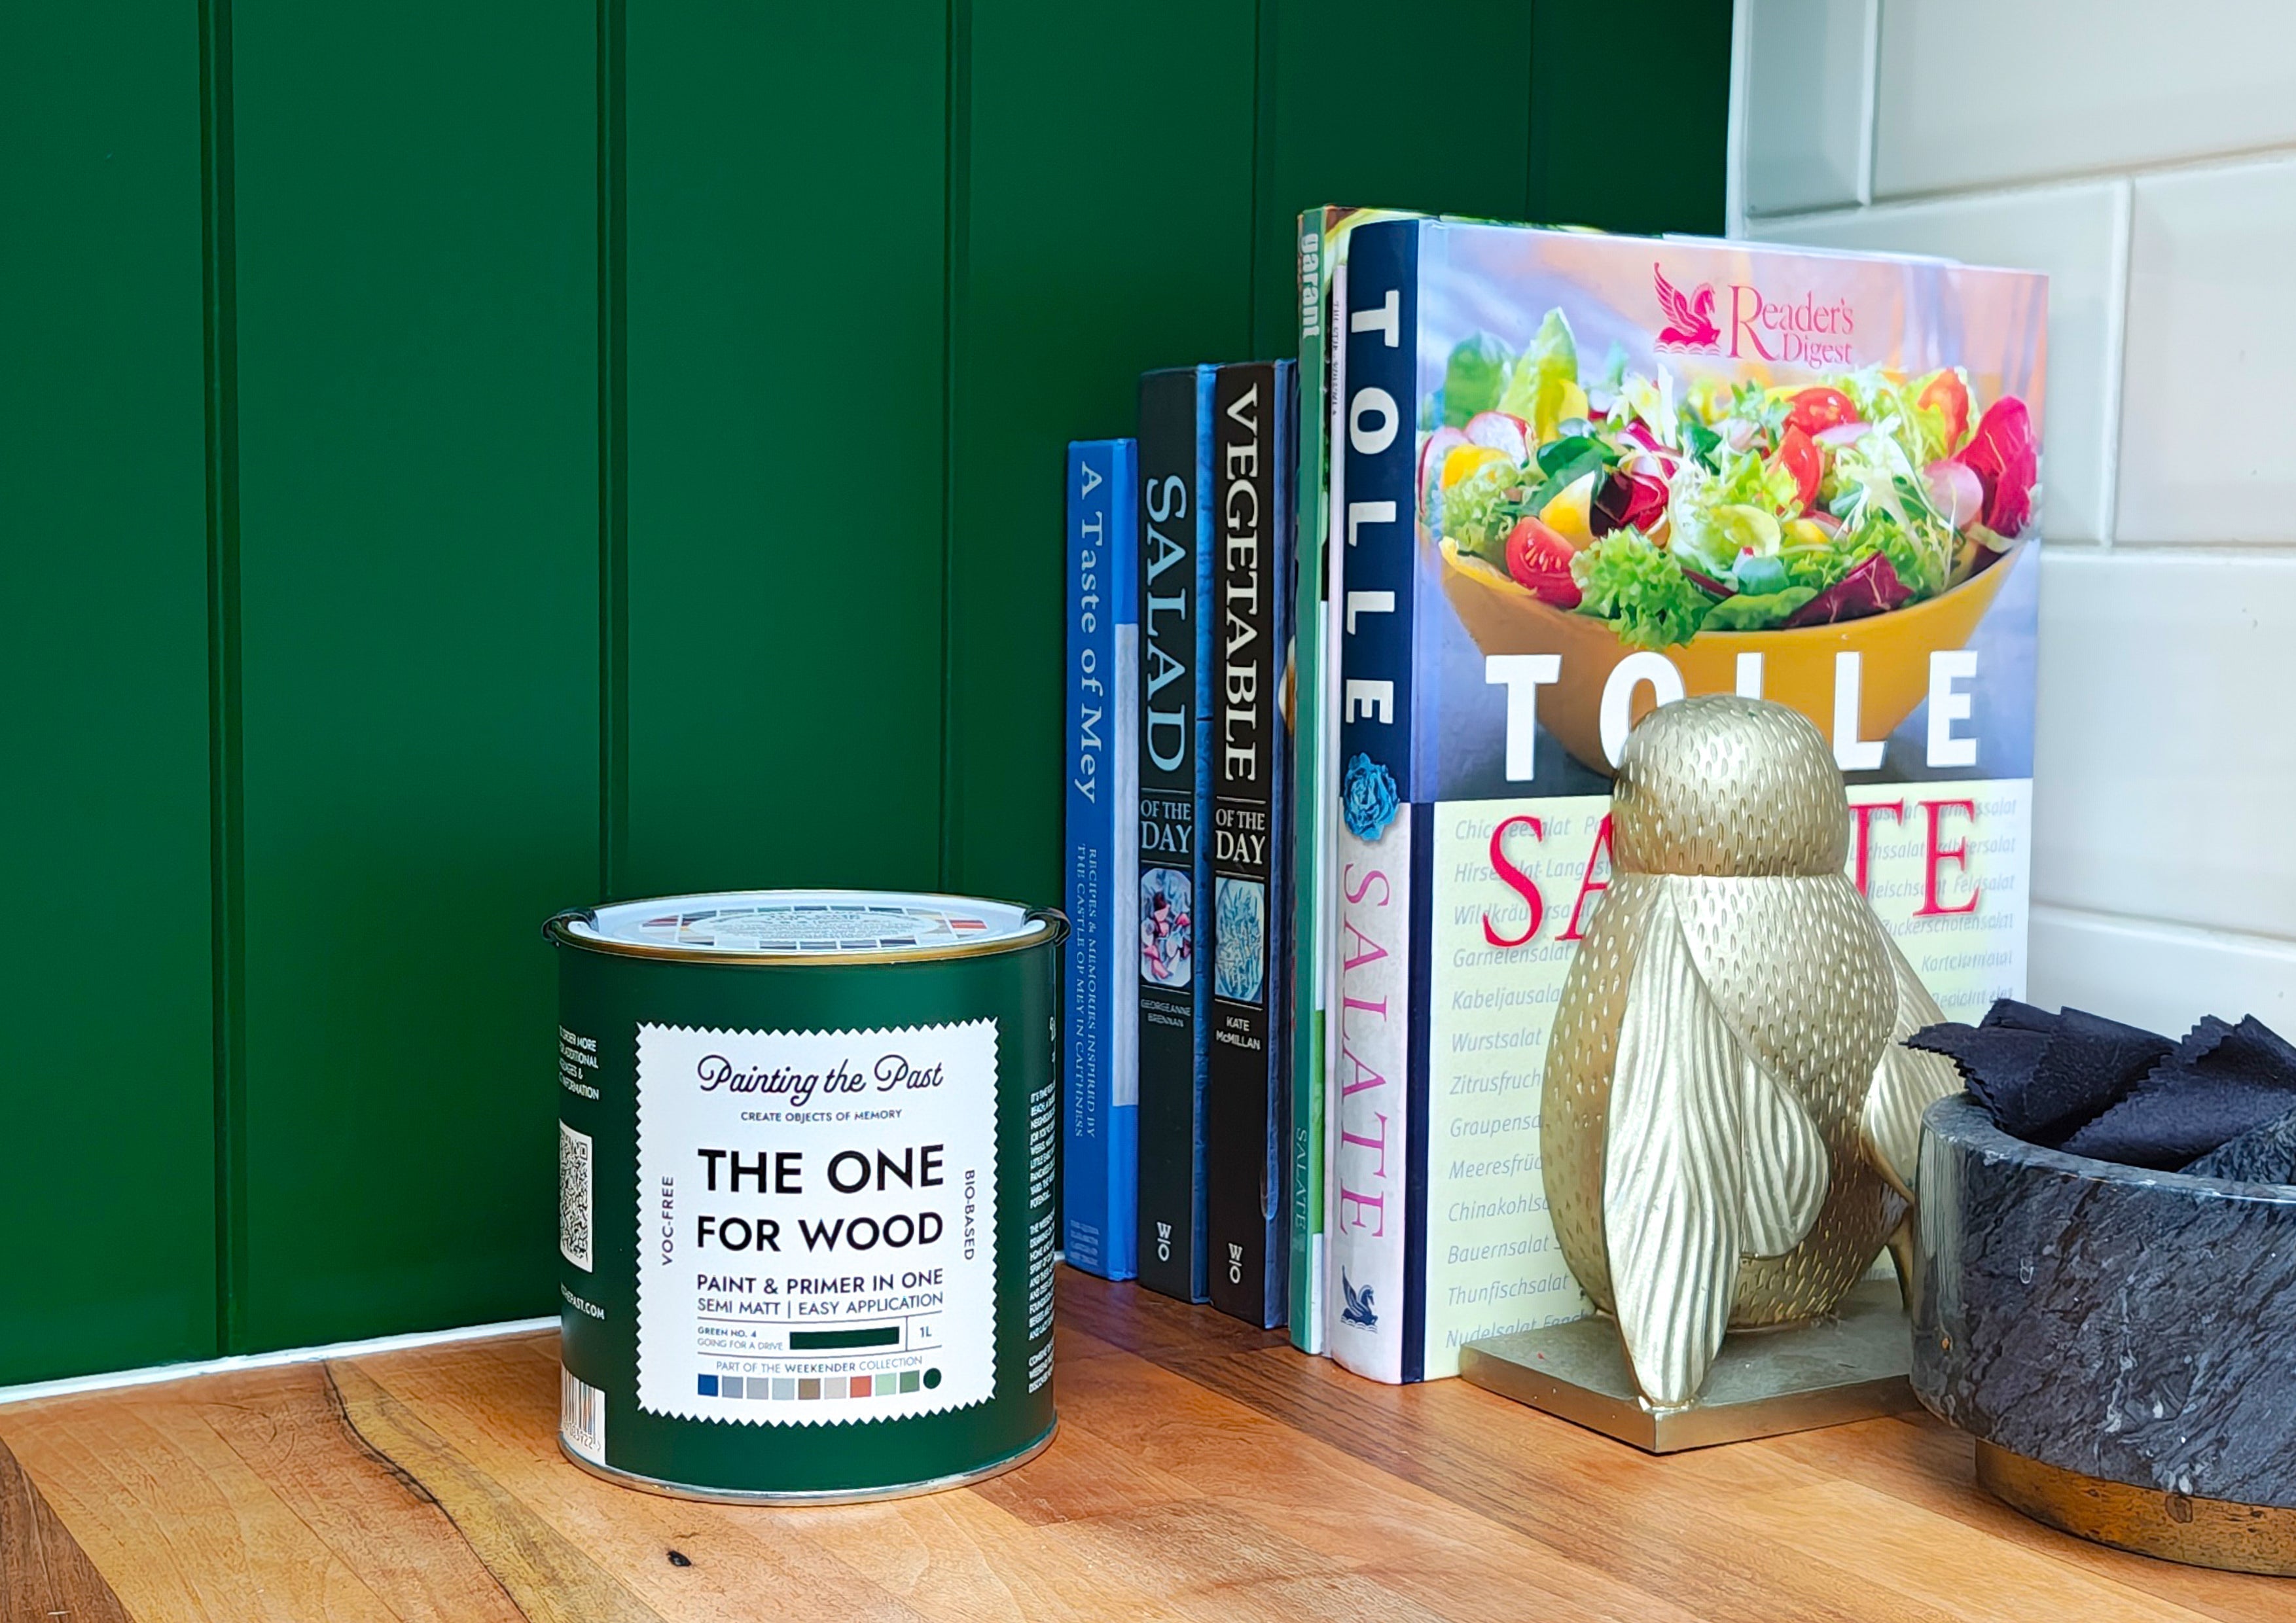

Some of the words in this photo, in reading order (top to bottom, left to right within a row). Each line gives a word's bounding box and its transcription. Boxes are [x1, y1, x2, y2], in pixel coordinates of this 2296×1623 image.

[1728, 285, 1854, 361] Reader's
[1783, 333, 1852, 369] Digest
[1081, 461, 1102, 499] A
[1346, 289, 1399, 724] TOLLE
[1081, 511, 1102, 634] Taste
[1225, 383, 1259, 781] VEGETABLE
[1145, 475, 1187, 774] SALAD
[1081, 648, 1103, 696] of
[1074, 705, 1102, 804] Mey
[1140, 799, 1160, 817] OF
[1162, 802, 1191, 821] THE
[1215, 808, 1235, 827] OF
[1236, 811, 1266, 830] THE
[1141, 821, 1193, 853] DAY
[1215, 830, 1266, 865] DAY
[1453, 942, 1571, 967] Garnelensalat
[1076, 978, 1085, 1014] MEY
[1452, 984, 1560, 1010] Kabeljausala
[1076, 1019, 1084, 1037] IN
[1227, 1016, 1249, 1031] KATE
[1452, 1027, 1541, 1053] Wurstsalat
[1340, 862, 1390, 1238] SALATE
[698, 1054, 819, 1107] Painting
[823, 1058, 867, 1092] the
[874, 1054, 944, 1092] Past
[1450, 1068, 1541, 1096] Zitrusfruch
[741, 1111, 781, 1122] CREATE
[785, 1112, 832, 1124] OBJECTS
[836, 1112, 851, 1121] OF
[854, 1109, 903, 1120] MEMORY
[698, 1149, 802, 1194] THE
[827, 1144, 944, 1194] ONE
[1295, 1128, 1307, 1230] SALATE
[662, 1176, 673, 1266] VOC-FREE
[964, 1169, 975, 1260] BIO-BASED
[698, 1215, 781, 1252] FOR
[798, 1211, 943, 1253] WOOD
[1448, 1234, 1549, 1264] Bauernsalat
[698, 1275, 757, 1293] PAINT
[764, 1279, 778, 1294] &
[787, 1277, 865, 1294] PRIMER
[873, 1274, 894, 1291] IN
[901, 1268, 943, 1288] ONE
[1449, 1274, 1569, 1306] Thunfischsalat
[698, 1298, 732, 1313] SEMI
[739, 1301, 781, 1315] MATT
[799, 1301, 840, 1315] EASY
[846, 1292, 943, 1314] APPLICATION
[698, 1327, 728, 1337] GREEN
[698, 1338, 727, 1348] GOING
[729, 1340, 747, 1349] FOR
[758, 1341, 783, 1351] DRIVE
[920, 1327, 932, 1338] 1L
[716, 1361, 741, 1372] PART
[744, 1363, 757, 1372] OF
[761, 1363, 781, 1373] THE
[785, 1363, 856, 1373] WEEKENDER
[859, 1355, 923, 1371] COLLECTION
